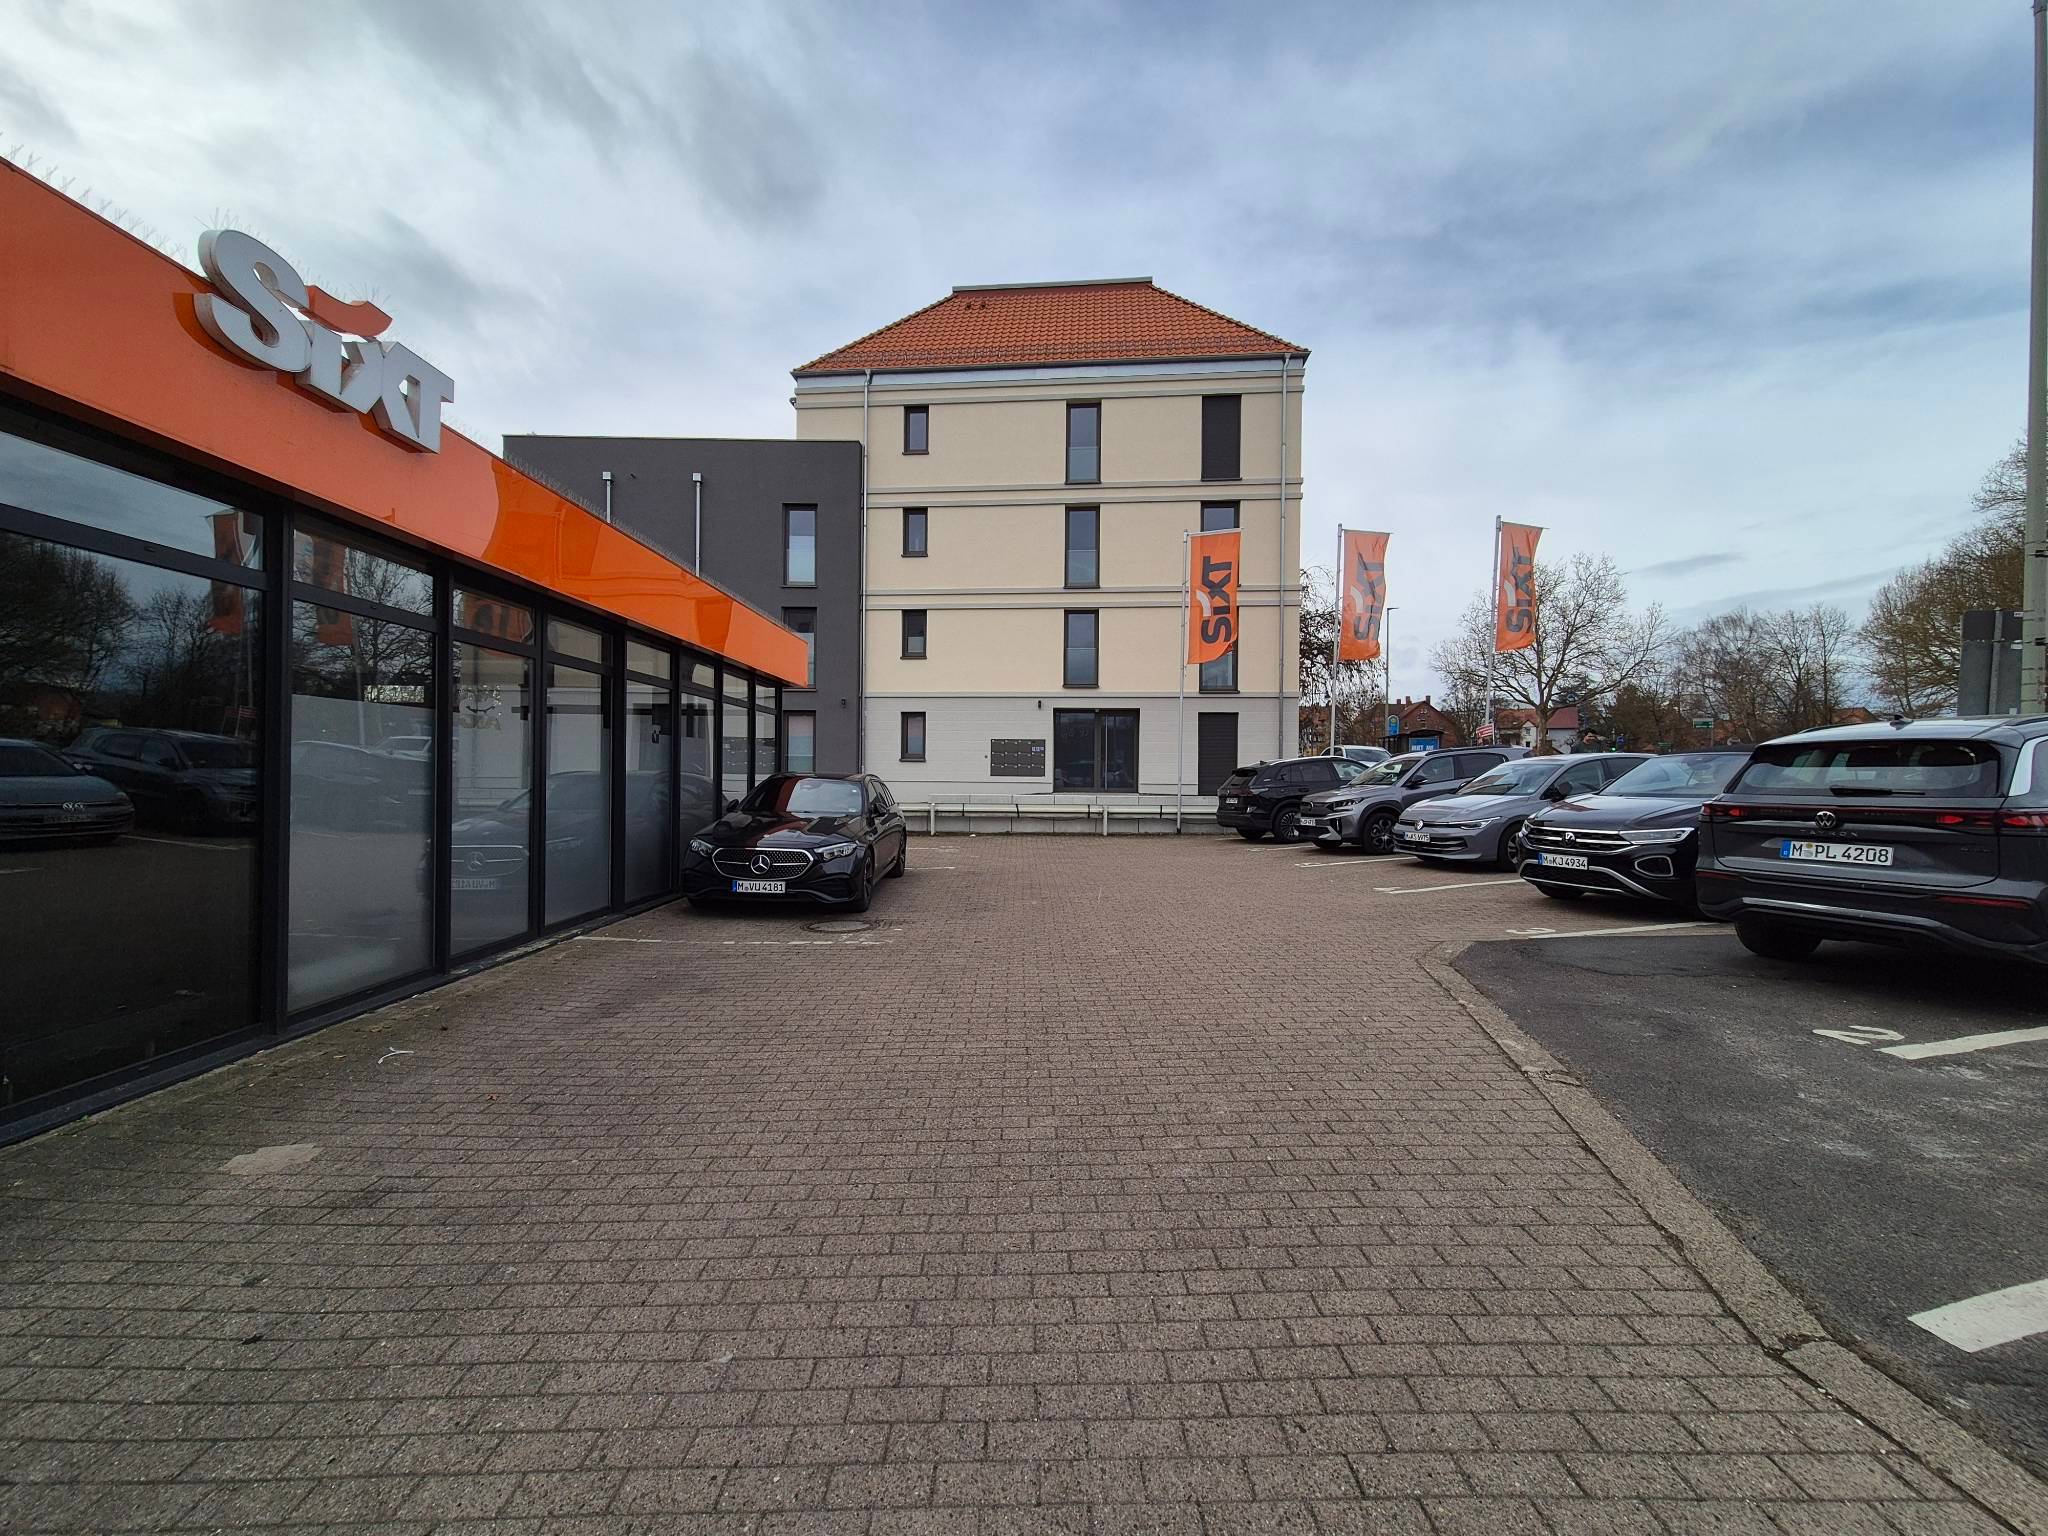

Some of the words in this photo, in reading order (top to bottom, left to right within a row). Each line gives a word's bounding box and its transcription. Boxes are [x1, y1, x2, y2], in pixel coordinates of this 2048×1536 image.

[1196, 556, 1233, 644] SIXT
[1350, 558, 1385, 641] SIXT
[1504, 550, 1535, 634] SIXT
[1552, 856, 1564, 866] KJ
[1565, 857, 1586, 869] 4934
[1791, 843, 1803, 857] M
[1815, 845, 1837, 859] PL
[1841, 846, 1890, 863] 4208
[762, 882, 784, 892] 4181
